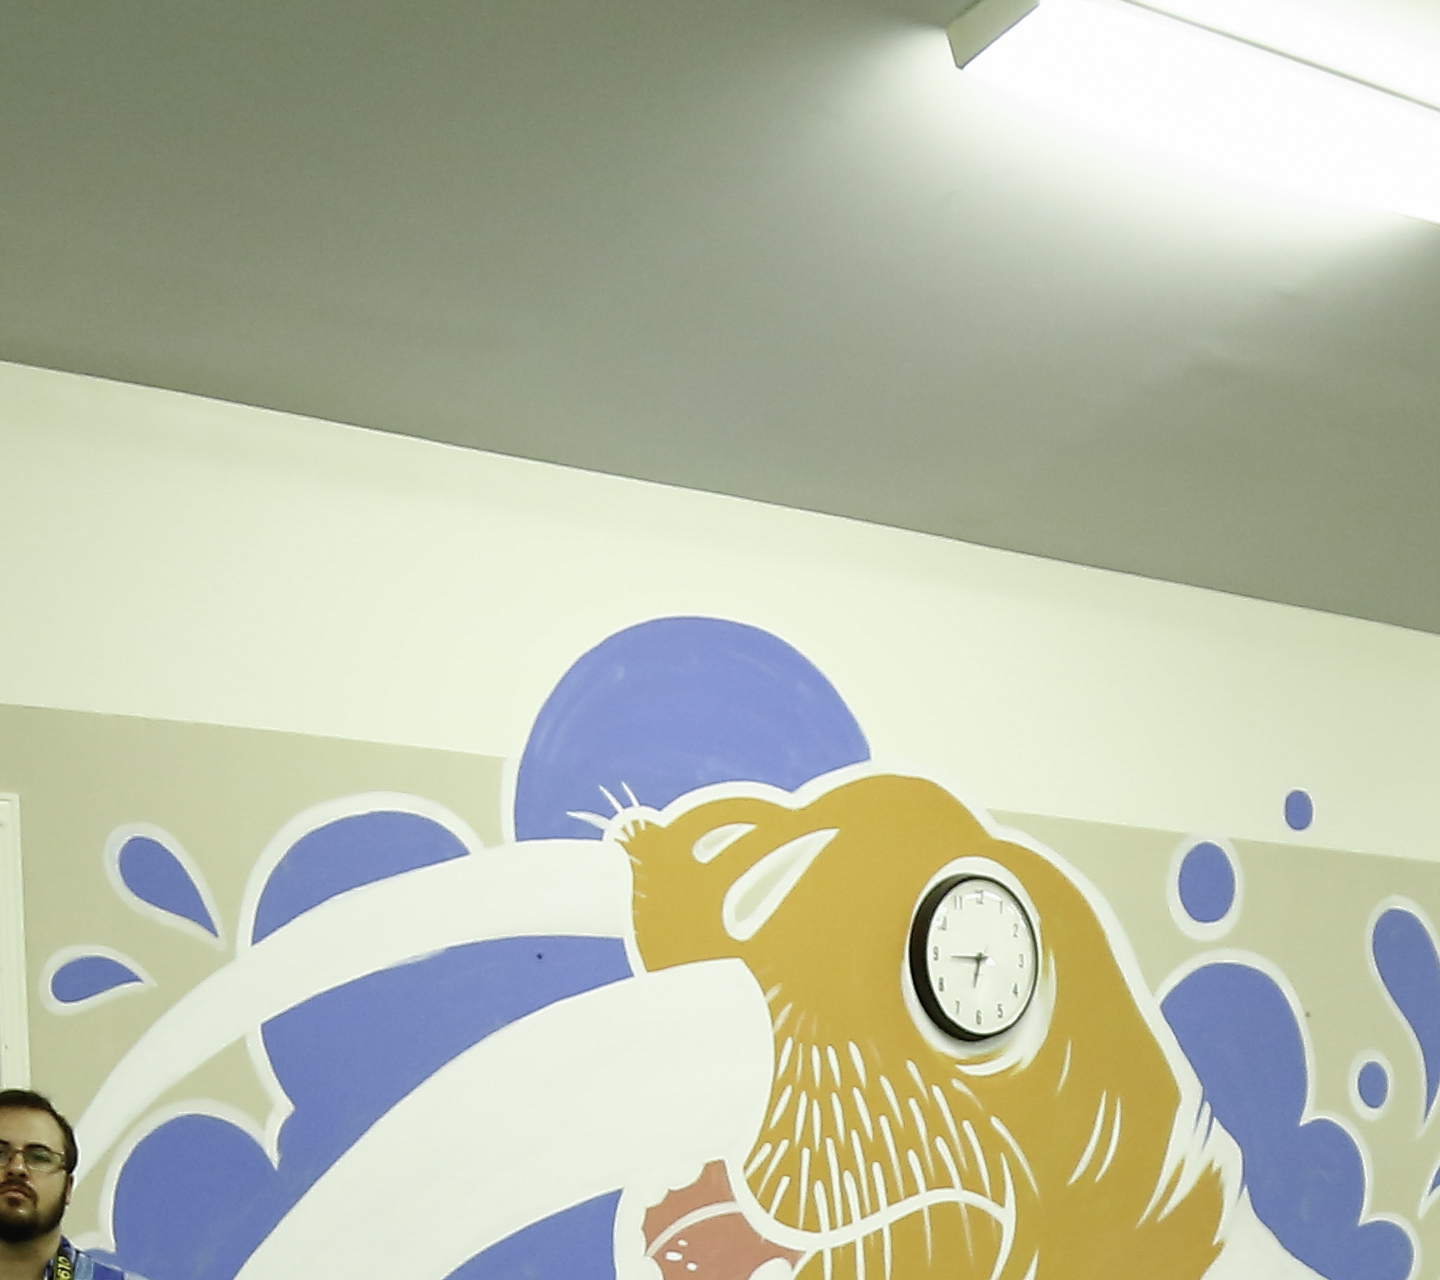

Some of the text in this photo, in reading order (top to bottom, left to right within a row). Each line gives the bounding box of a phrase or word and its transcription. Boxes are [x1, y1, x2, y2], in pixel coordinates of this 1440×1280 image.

[954, 895, 963, 910] 11
[1012, 923, 1019, 938] 2
[932, 946, 939, 961] 9
[1018, 953, 1025, 969] 3
[938, 977, 945, 992] 8
[1012, 982, 1019, 998] 4
[954, 1000, 961, 1015] 7
[997, 1003, 1004, 1019] 5
[975, 1010, 983, 1025] 6
